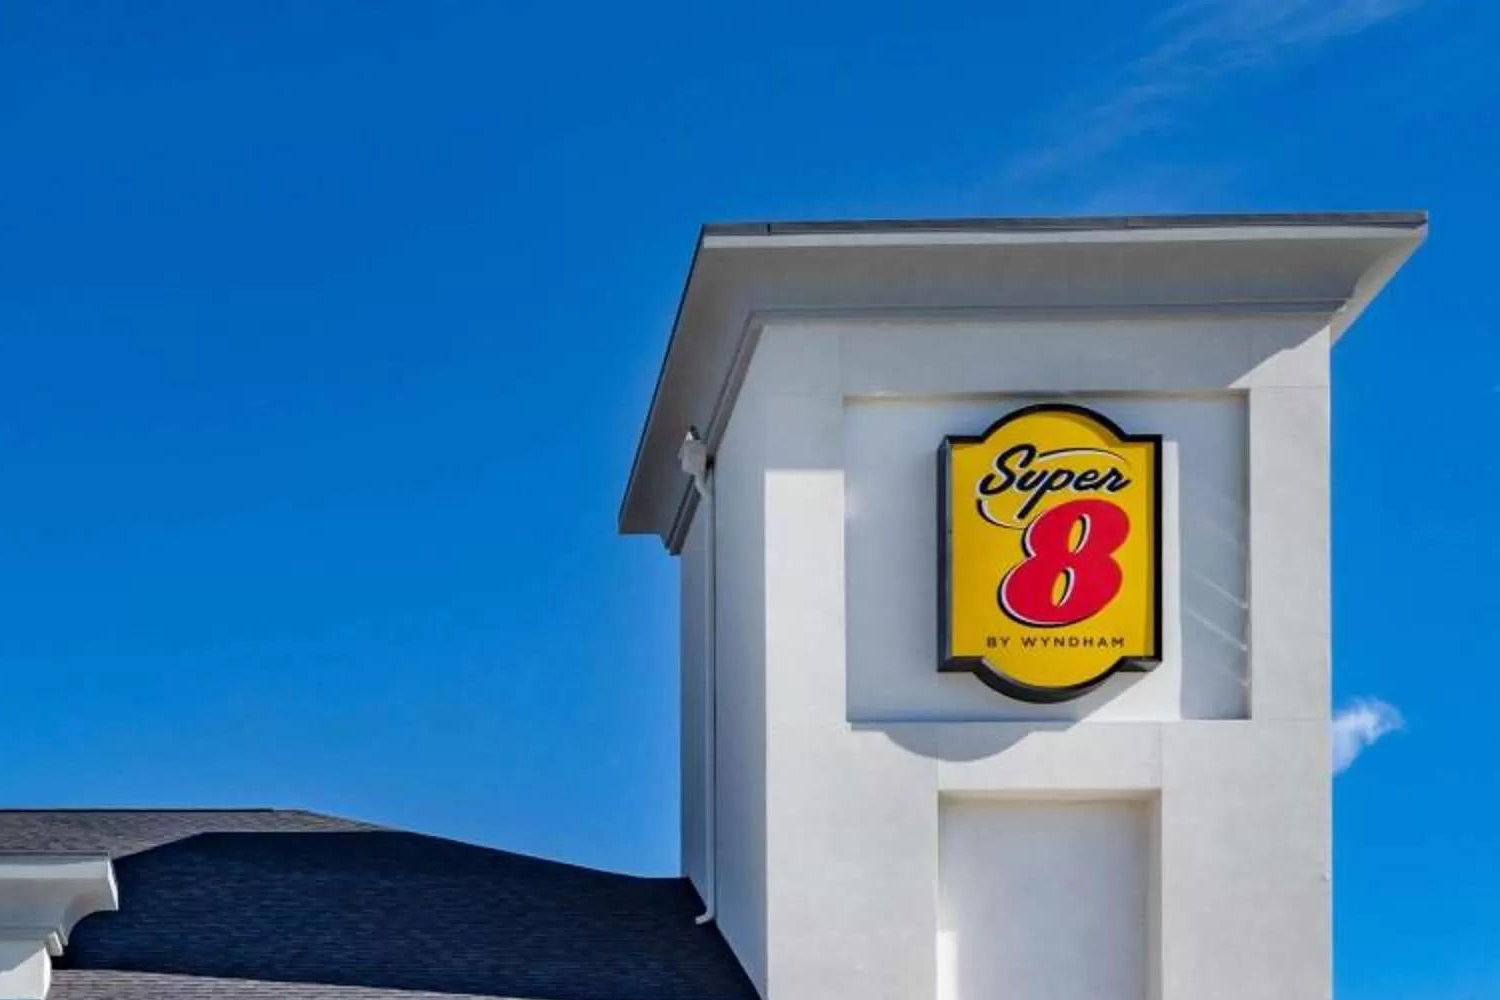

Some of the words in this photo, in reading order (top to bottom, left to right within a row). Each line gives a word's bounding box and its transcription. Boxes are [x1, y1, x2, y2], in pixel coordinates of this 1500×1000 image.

[978, 443, 1132, 521] Super
[997, 497, 1131, 628] 8
[986, 635, 1011, 649] BY
[1020, 635, 1126, 649] WYNDHAM
